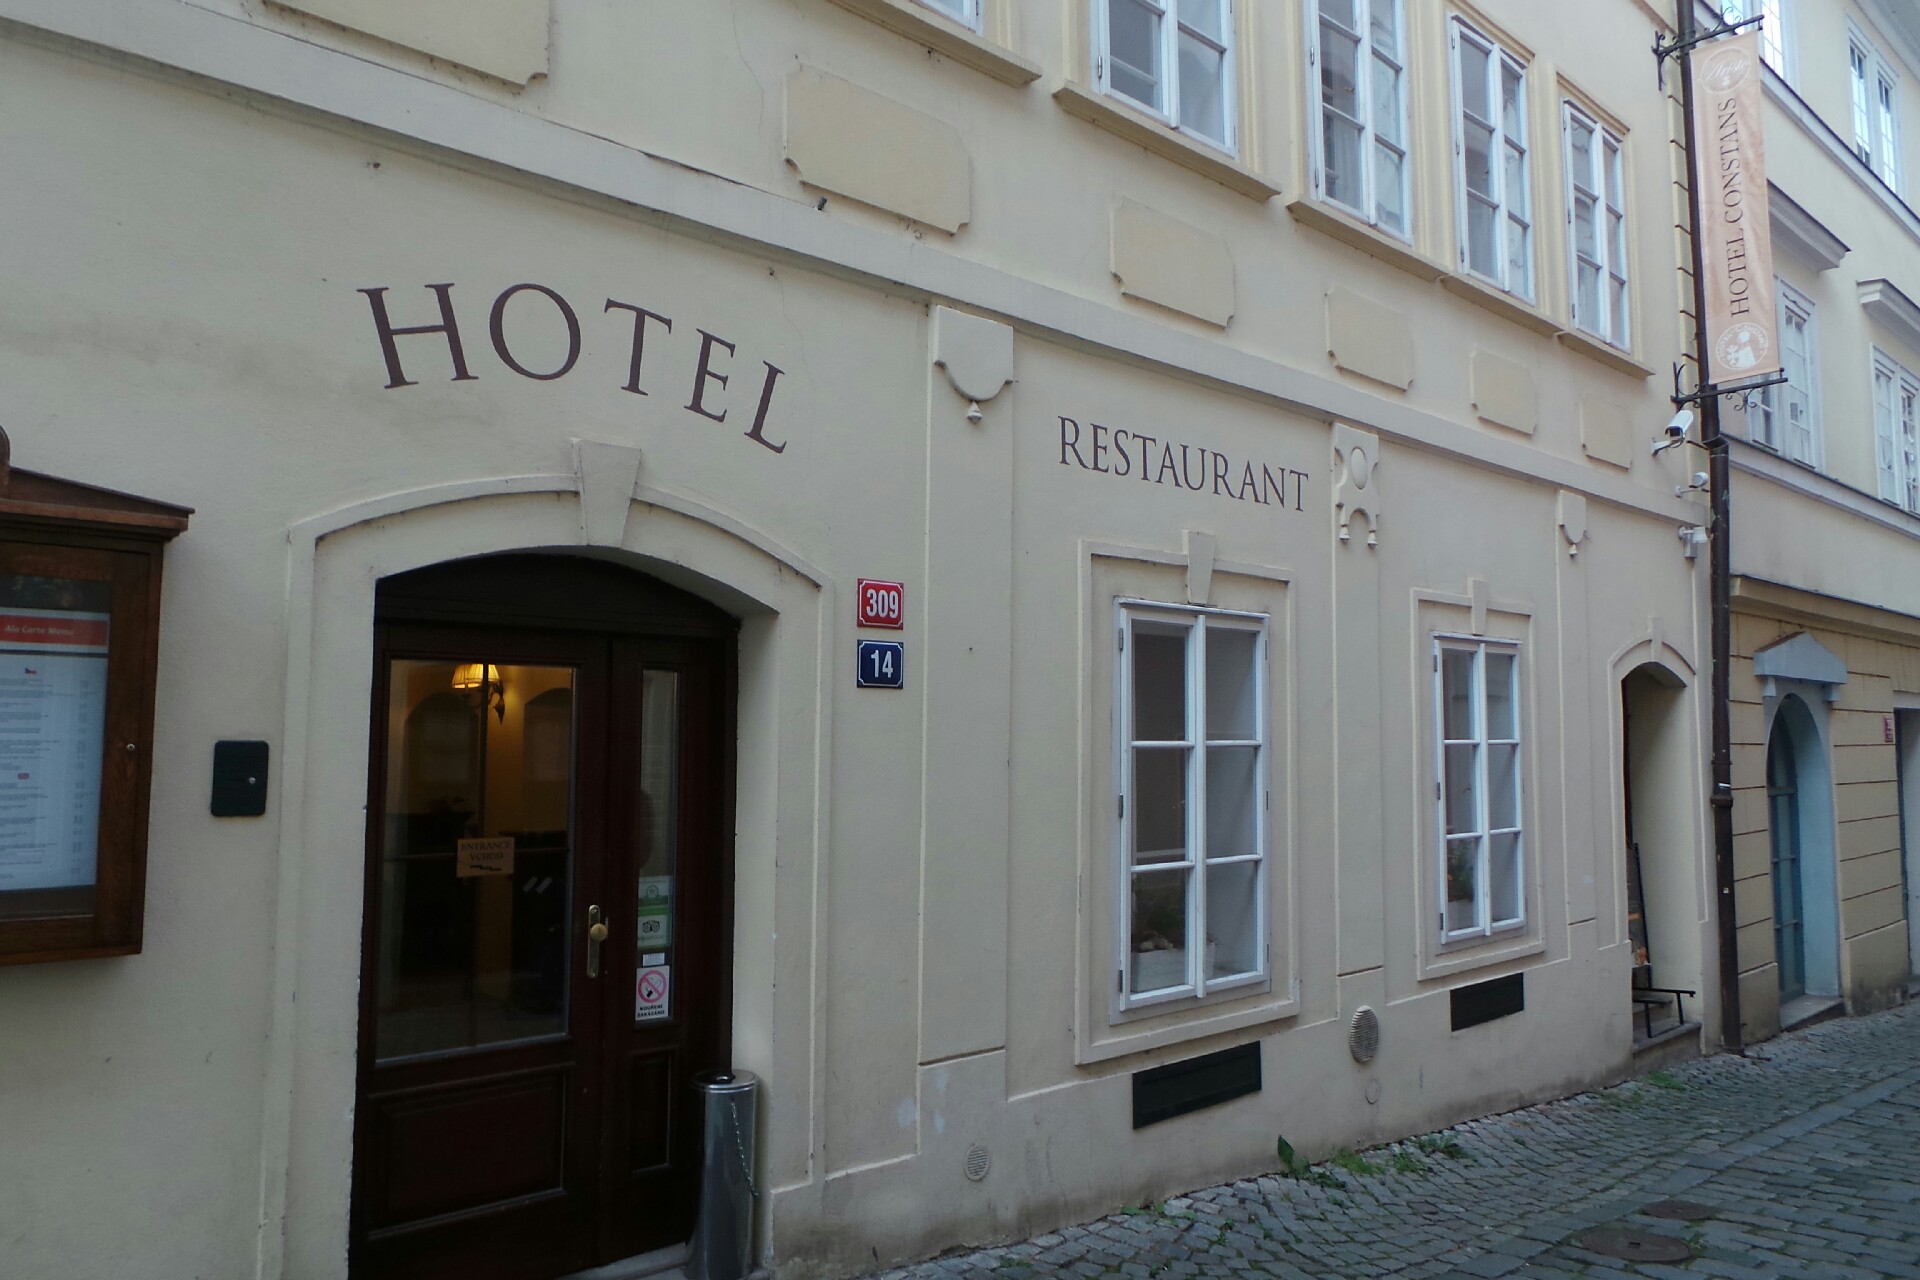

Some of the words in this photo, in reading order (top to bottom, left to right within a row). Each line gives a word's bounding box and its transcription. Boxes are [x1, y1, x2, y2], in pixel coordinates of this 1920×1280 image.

[1718, 97, 1744, 224] CONSTANS
[1726, 228, 1750, 317] HOTEL
[356, 282, 787, 454] HOTEL
[1057, 415, 1309, 512] RESTAURANT
[866, 589, 899, 618] 309
[22, 626, 46, 635] Carte
[47, 627, 74, 636] Menu
[870, 649, 894, 678] 14
[461, 841, 513, 851] ENTRANCE
[470, 851, 504, 861] VCHOD
